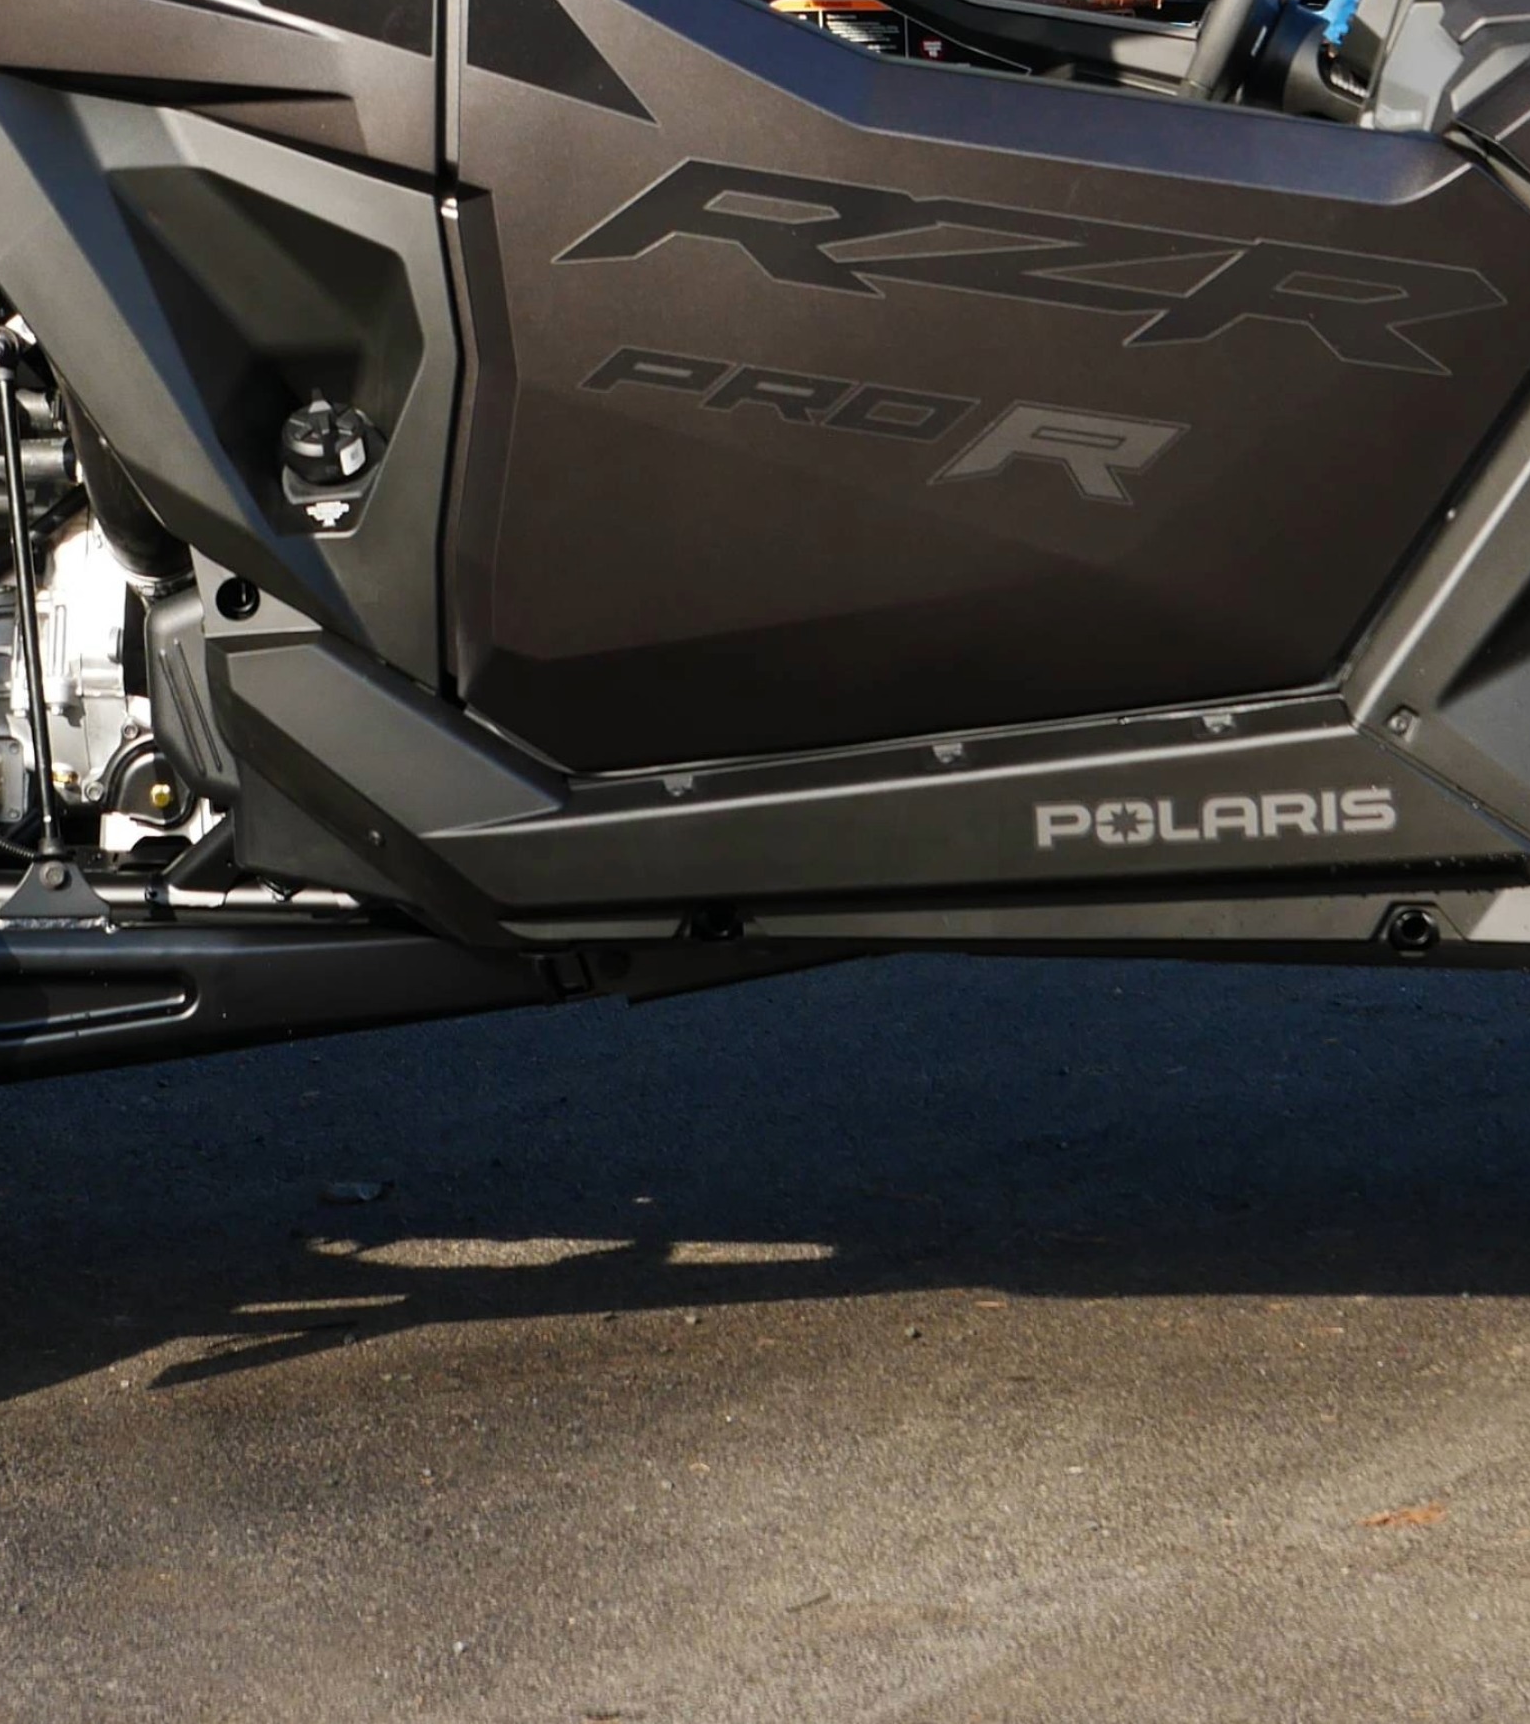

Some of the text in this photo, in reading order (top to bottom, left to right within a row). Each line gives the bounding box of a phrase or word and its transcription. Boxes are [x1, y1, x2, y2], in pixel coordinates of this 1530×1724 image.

[551, 157, 1507, 375] RZR
[577, 345, 1191, 505] PRO R
[1035, 788, 1397, 847] POLARIS
